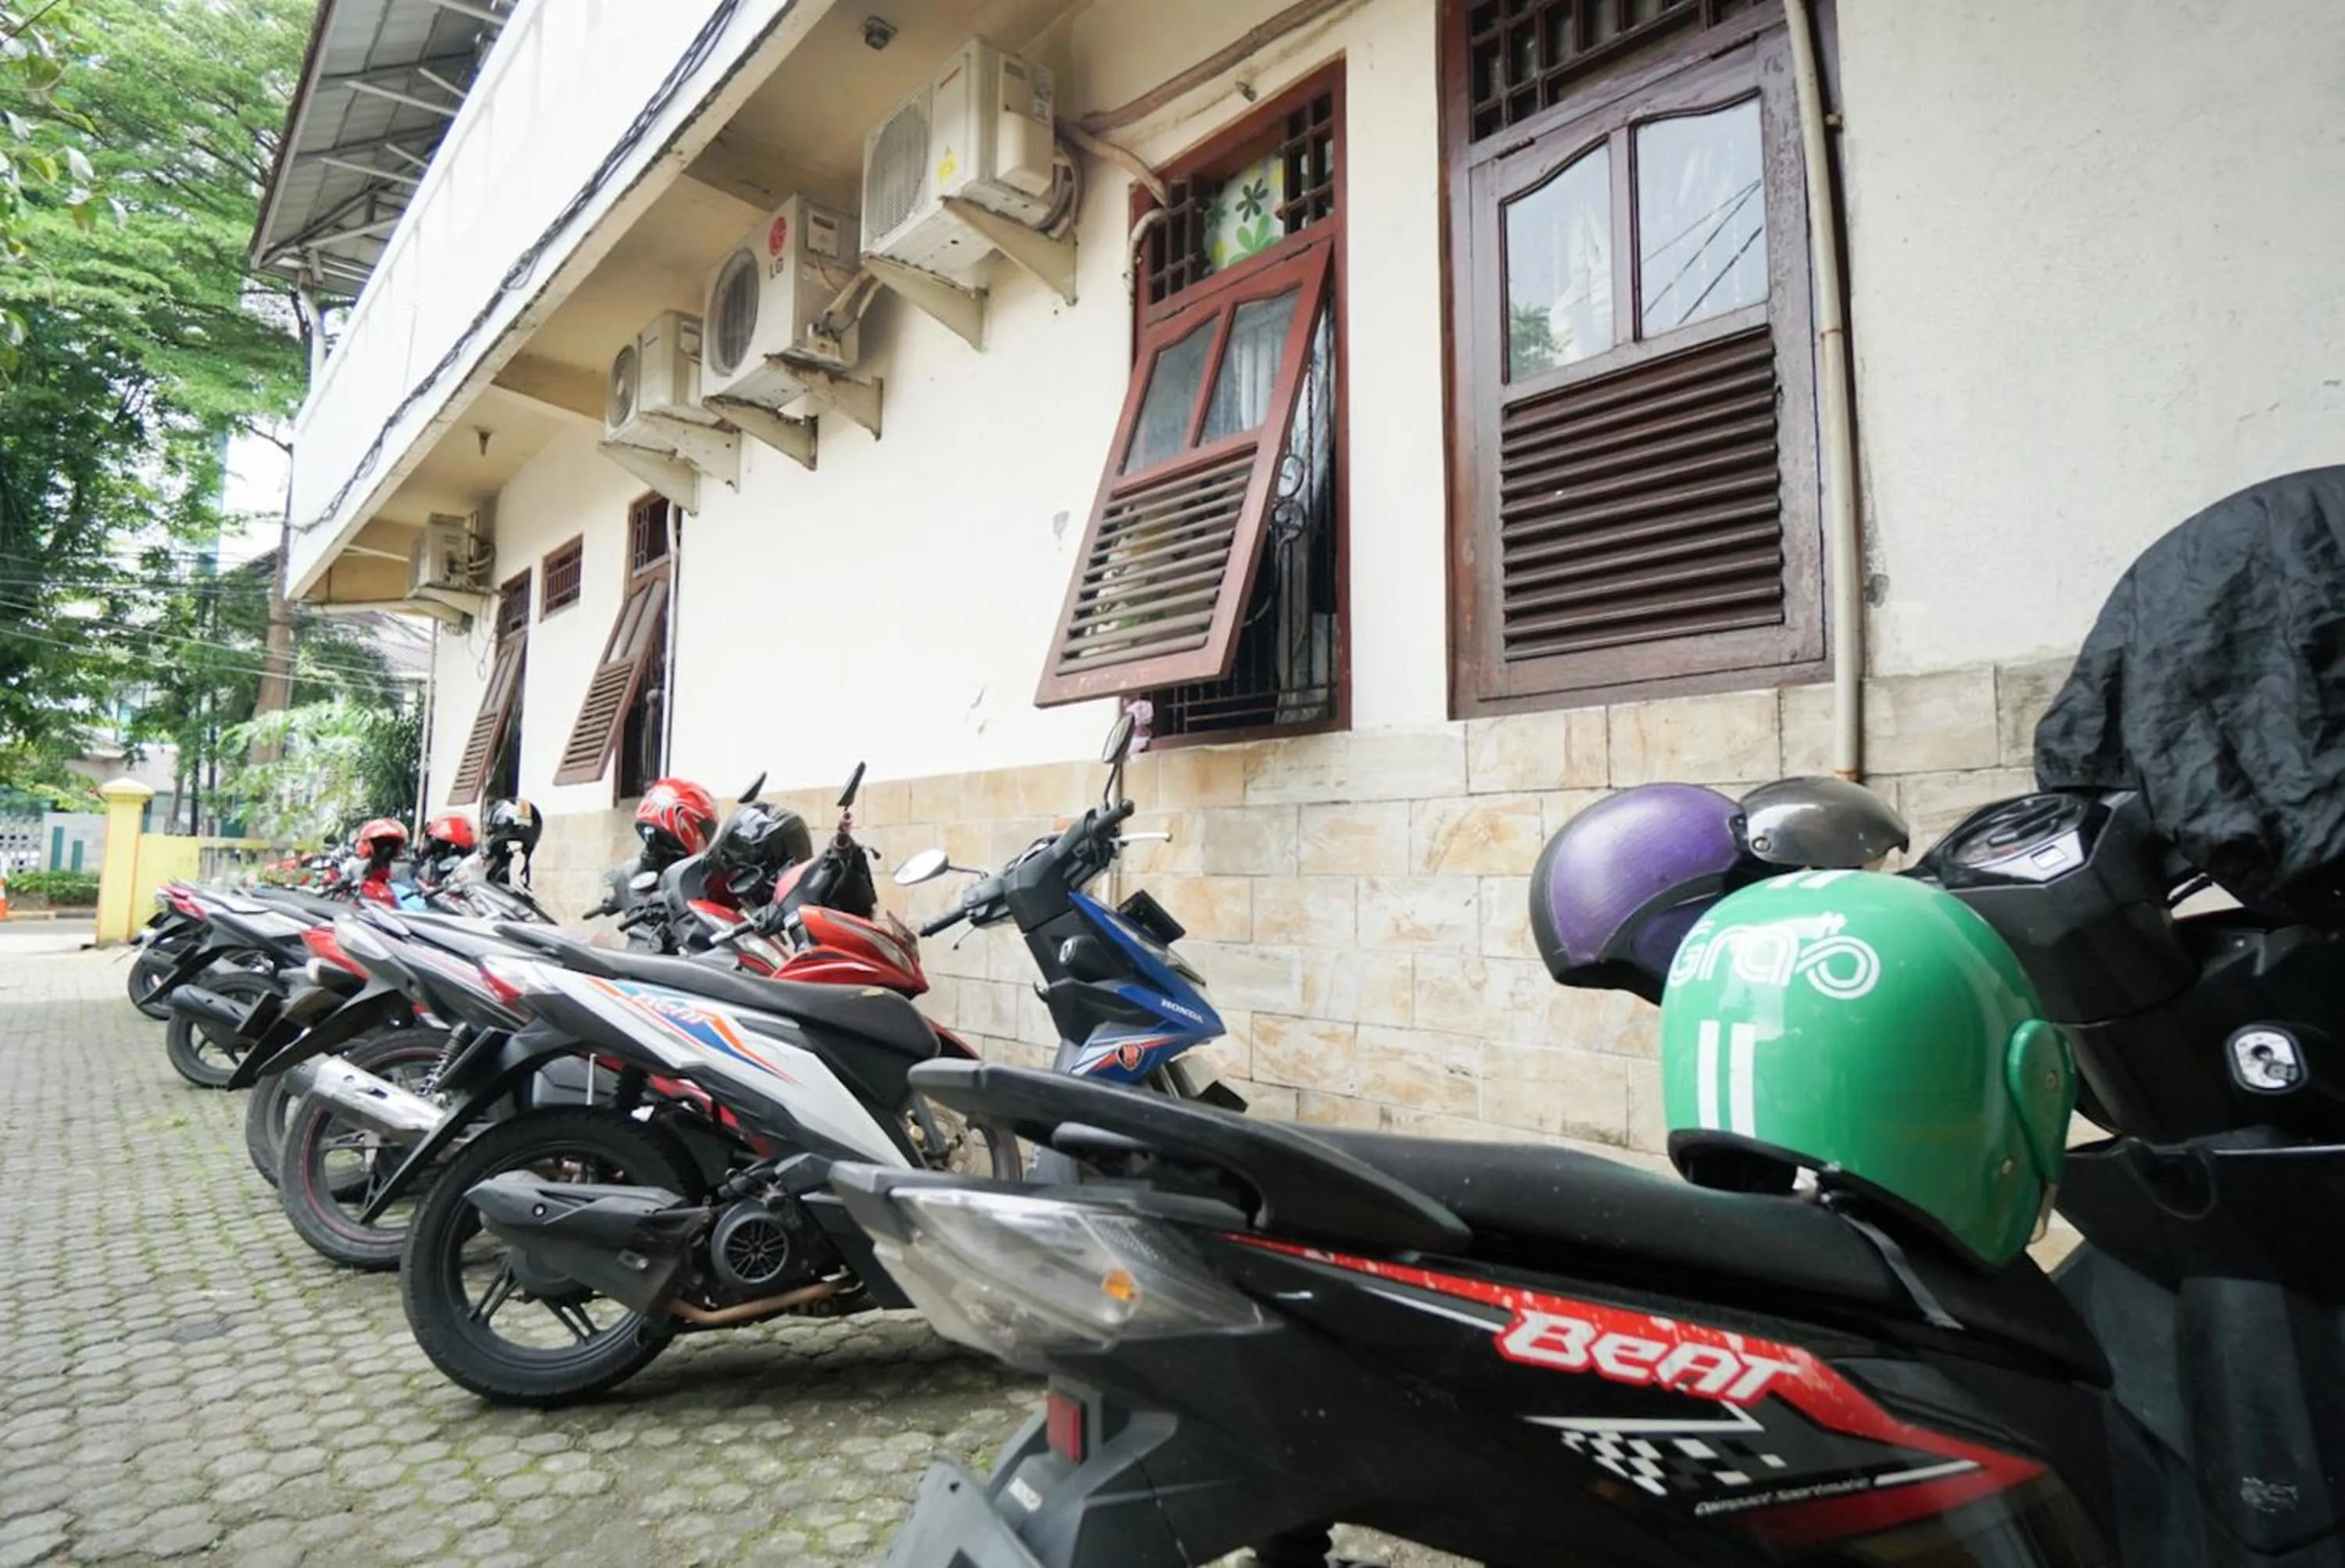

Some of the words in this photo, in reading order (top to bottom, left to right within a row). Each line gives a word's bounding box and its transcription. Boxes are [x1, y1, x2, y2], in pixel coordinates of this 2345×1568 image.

[769, 256, 784, 280] LG
[1668, 912, 1881, 1000] Grab
[1160, 998, 1203, 1024] HONDA
[1502, 1308, 1801, 1400] BeAT
